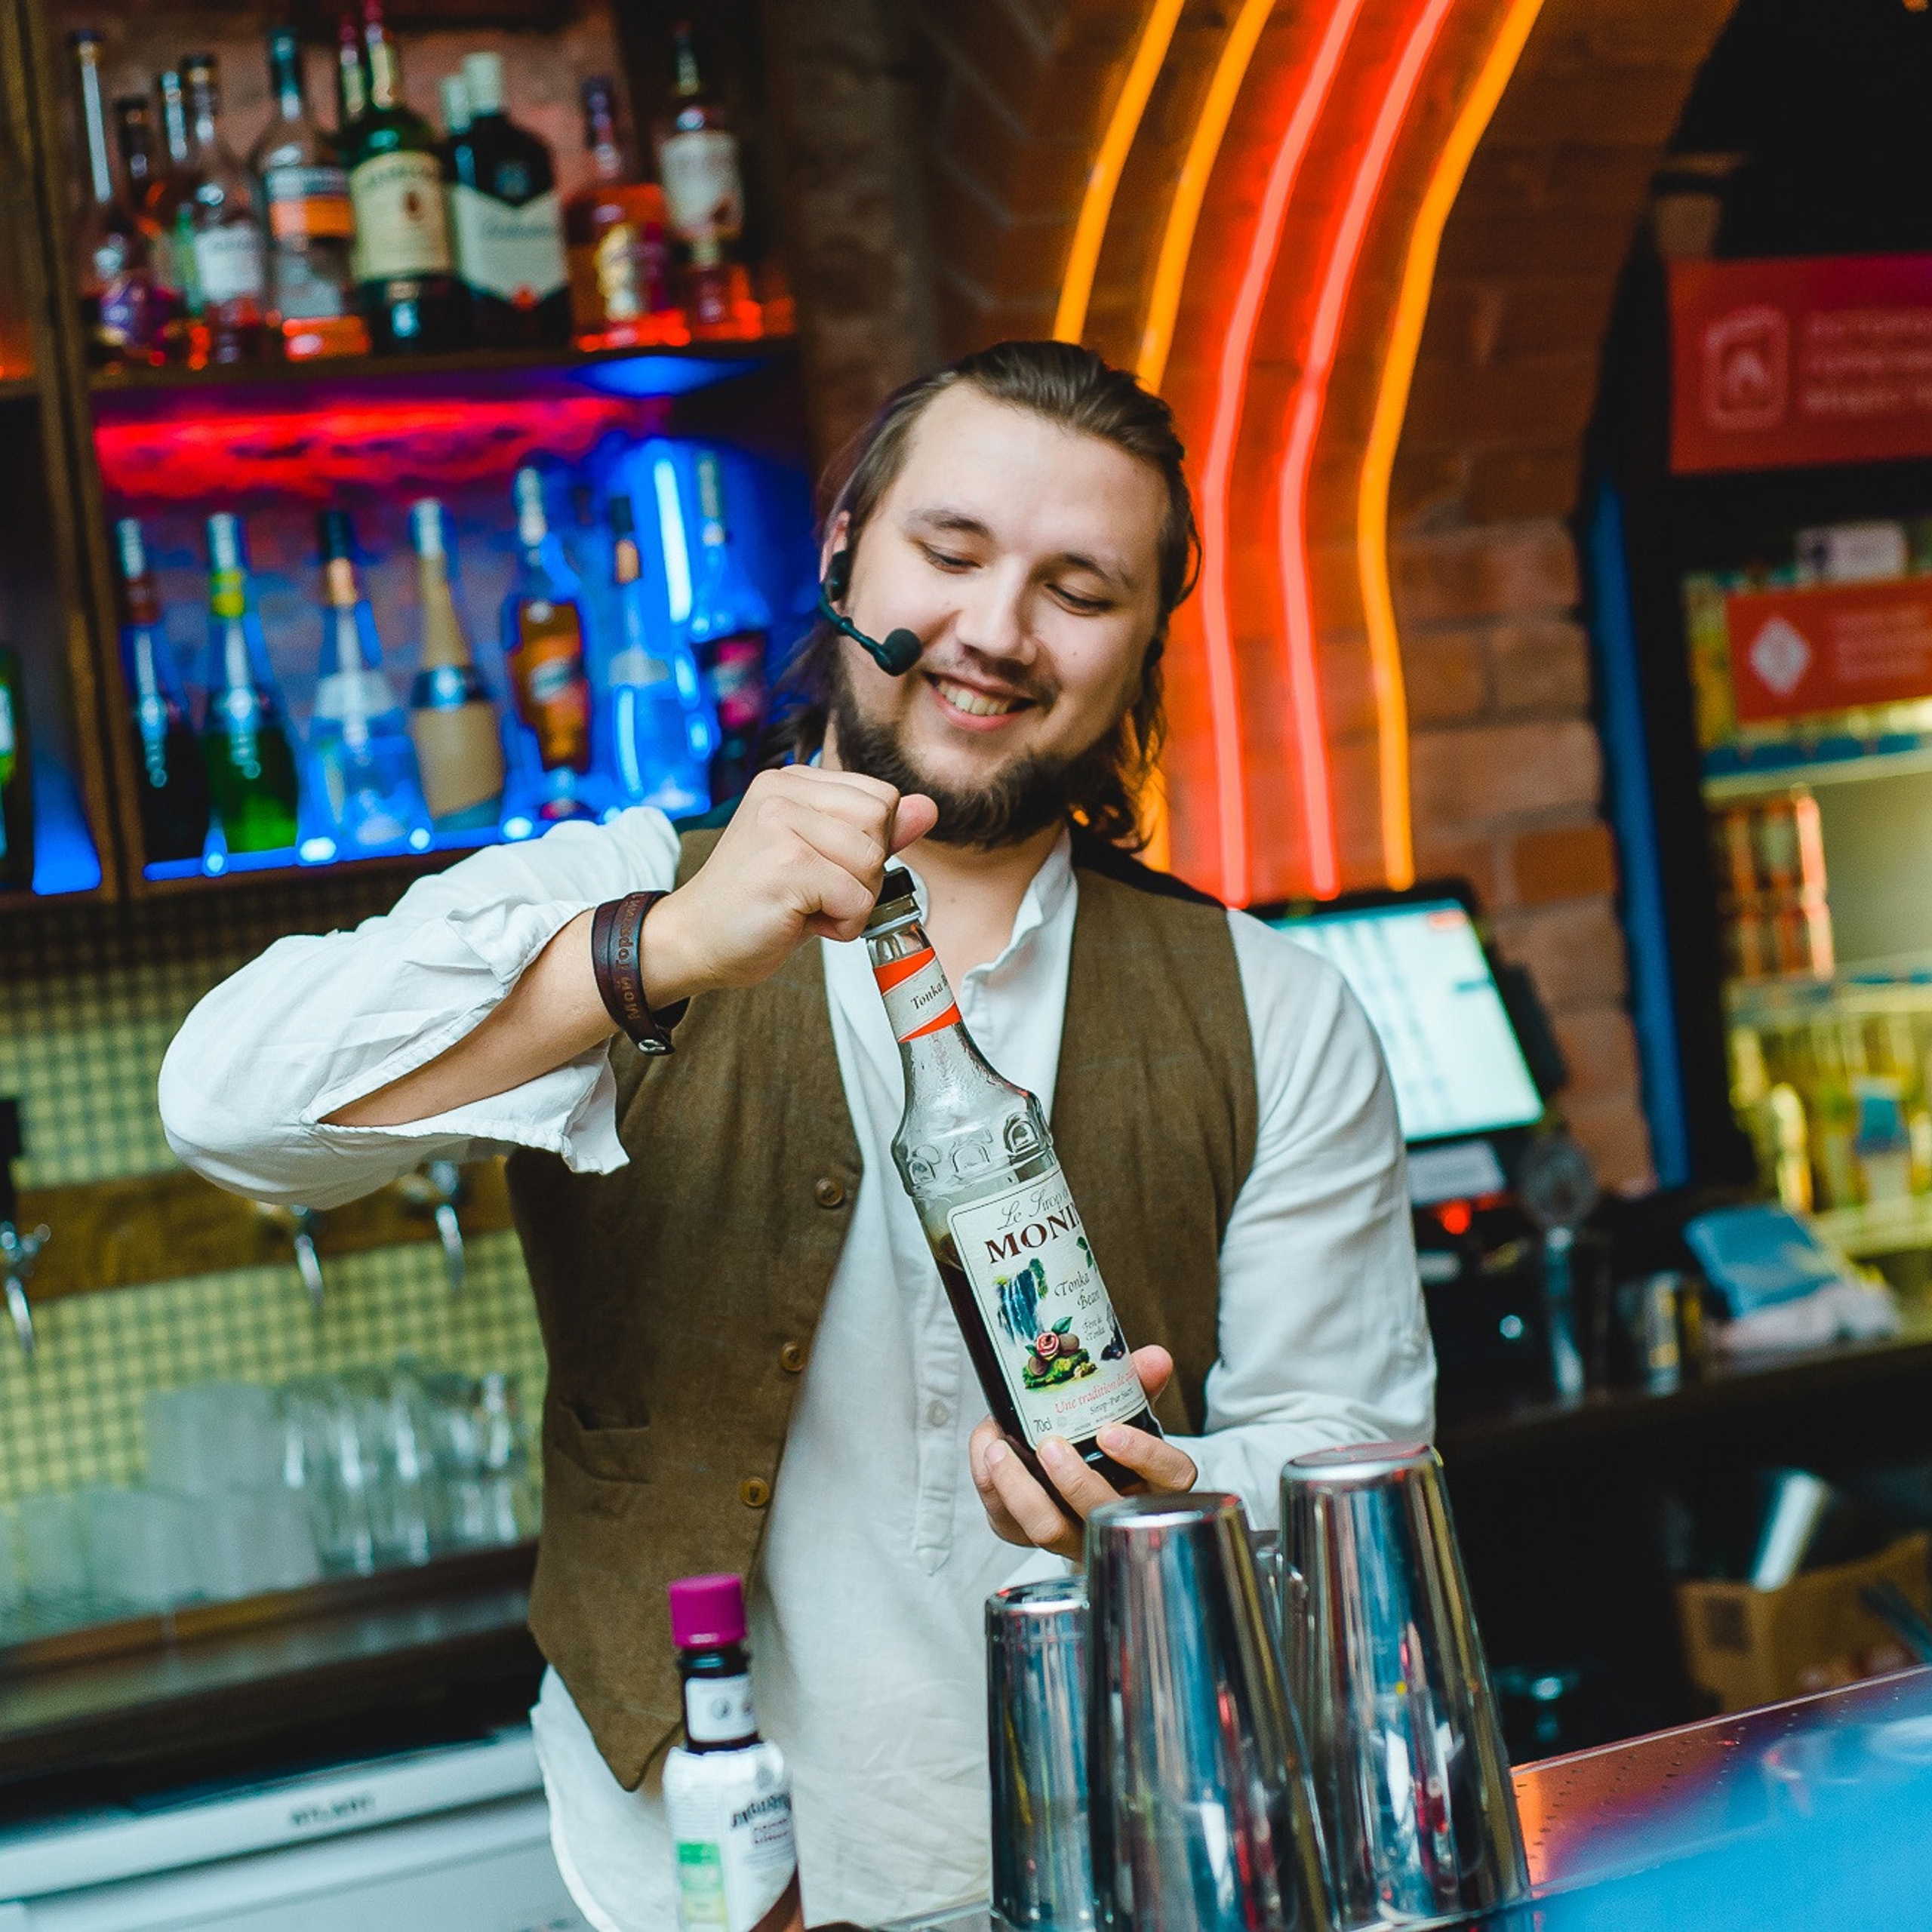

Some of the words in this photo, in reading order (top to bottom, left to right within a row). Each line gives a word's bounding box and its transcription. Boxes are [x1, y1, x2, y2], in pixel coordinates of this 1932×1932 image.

[910, 983, 943, 1010] Tonka
[997, 1200, 1022, 1231] Le
[1028, 1189, 1063, 1217] Sirop
[1054, 1271, 1090, 1297] Tonka
